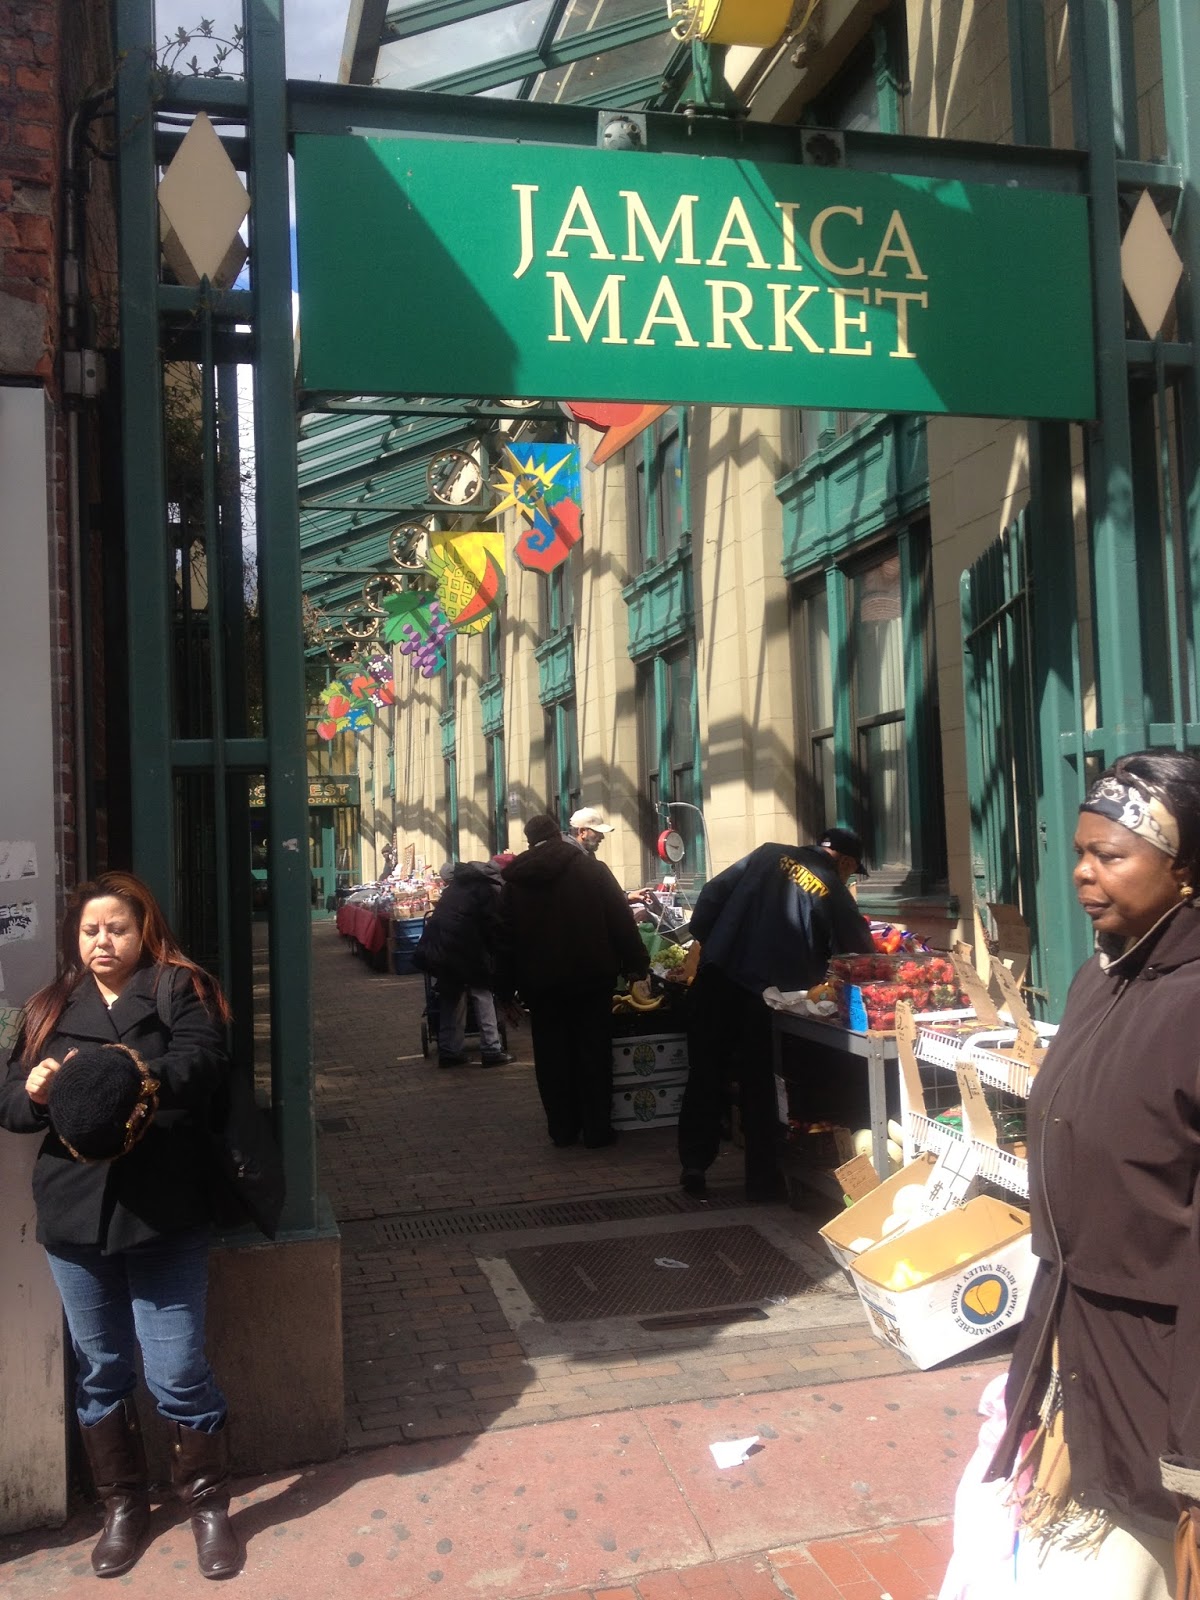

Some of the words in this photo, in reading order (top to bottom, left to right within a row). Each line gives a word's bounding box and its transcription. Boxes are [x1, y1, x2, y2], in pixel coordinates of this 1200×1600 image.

[511, 183, 928, 280] JAMAICA
[546, 271, 928, 359] MARKET
[307, 797, 347, 805] OPPING
[309, 784, 349, 797] EST
[780, 855, 829, 897] SECURITY
[963, 1264, 993, 1283] VALLEY
[995, 1264, 1017, 1286] RIVER
[951, 1283, 963, 1315] PEARS
[1005, 1287, 1018, 1318] UPPER
[954, 1315, 1005, 1336] WENATCHEE
